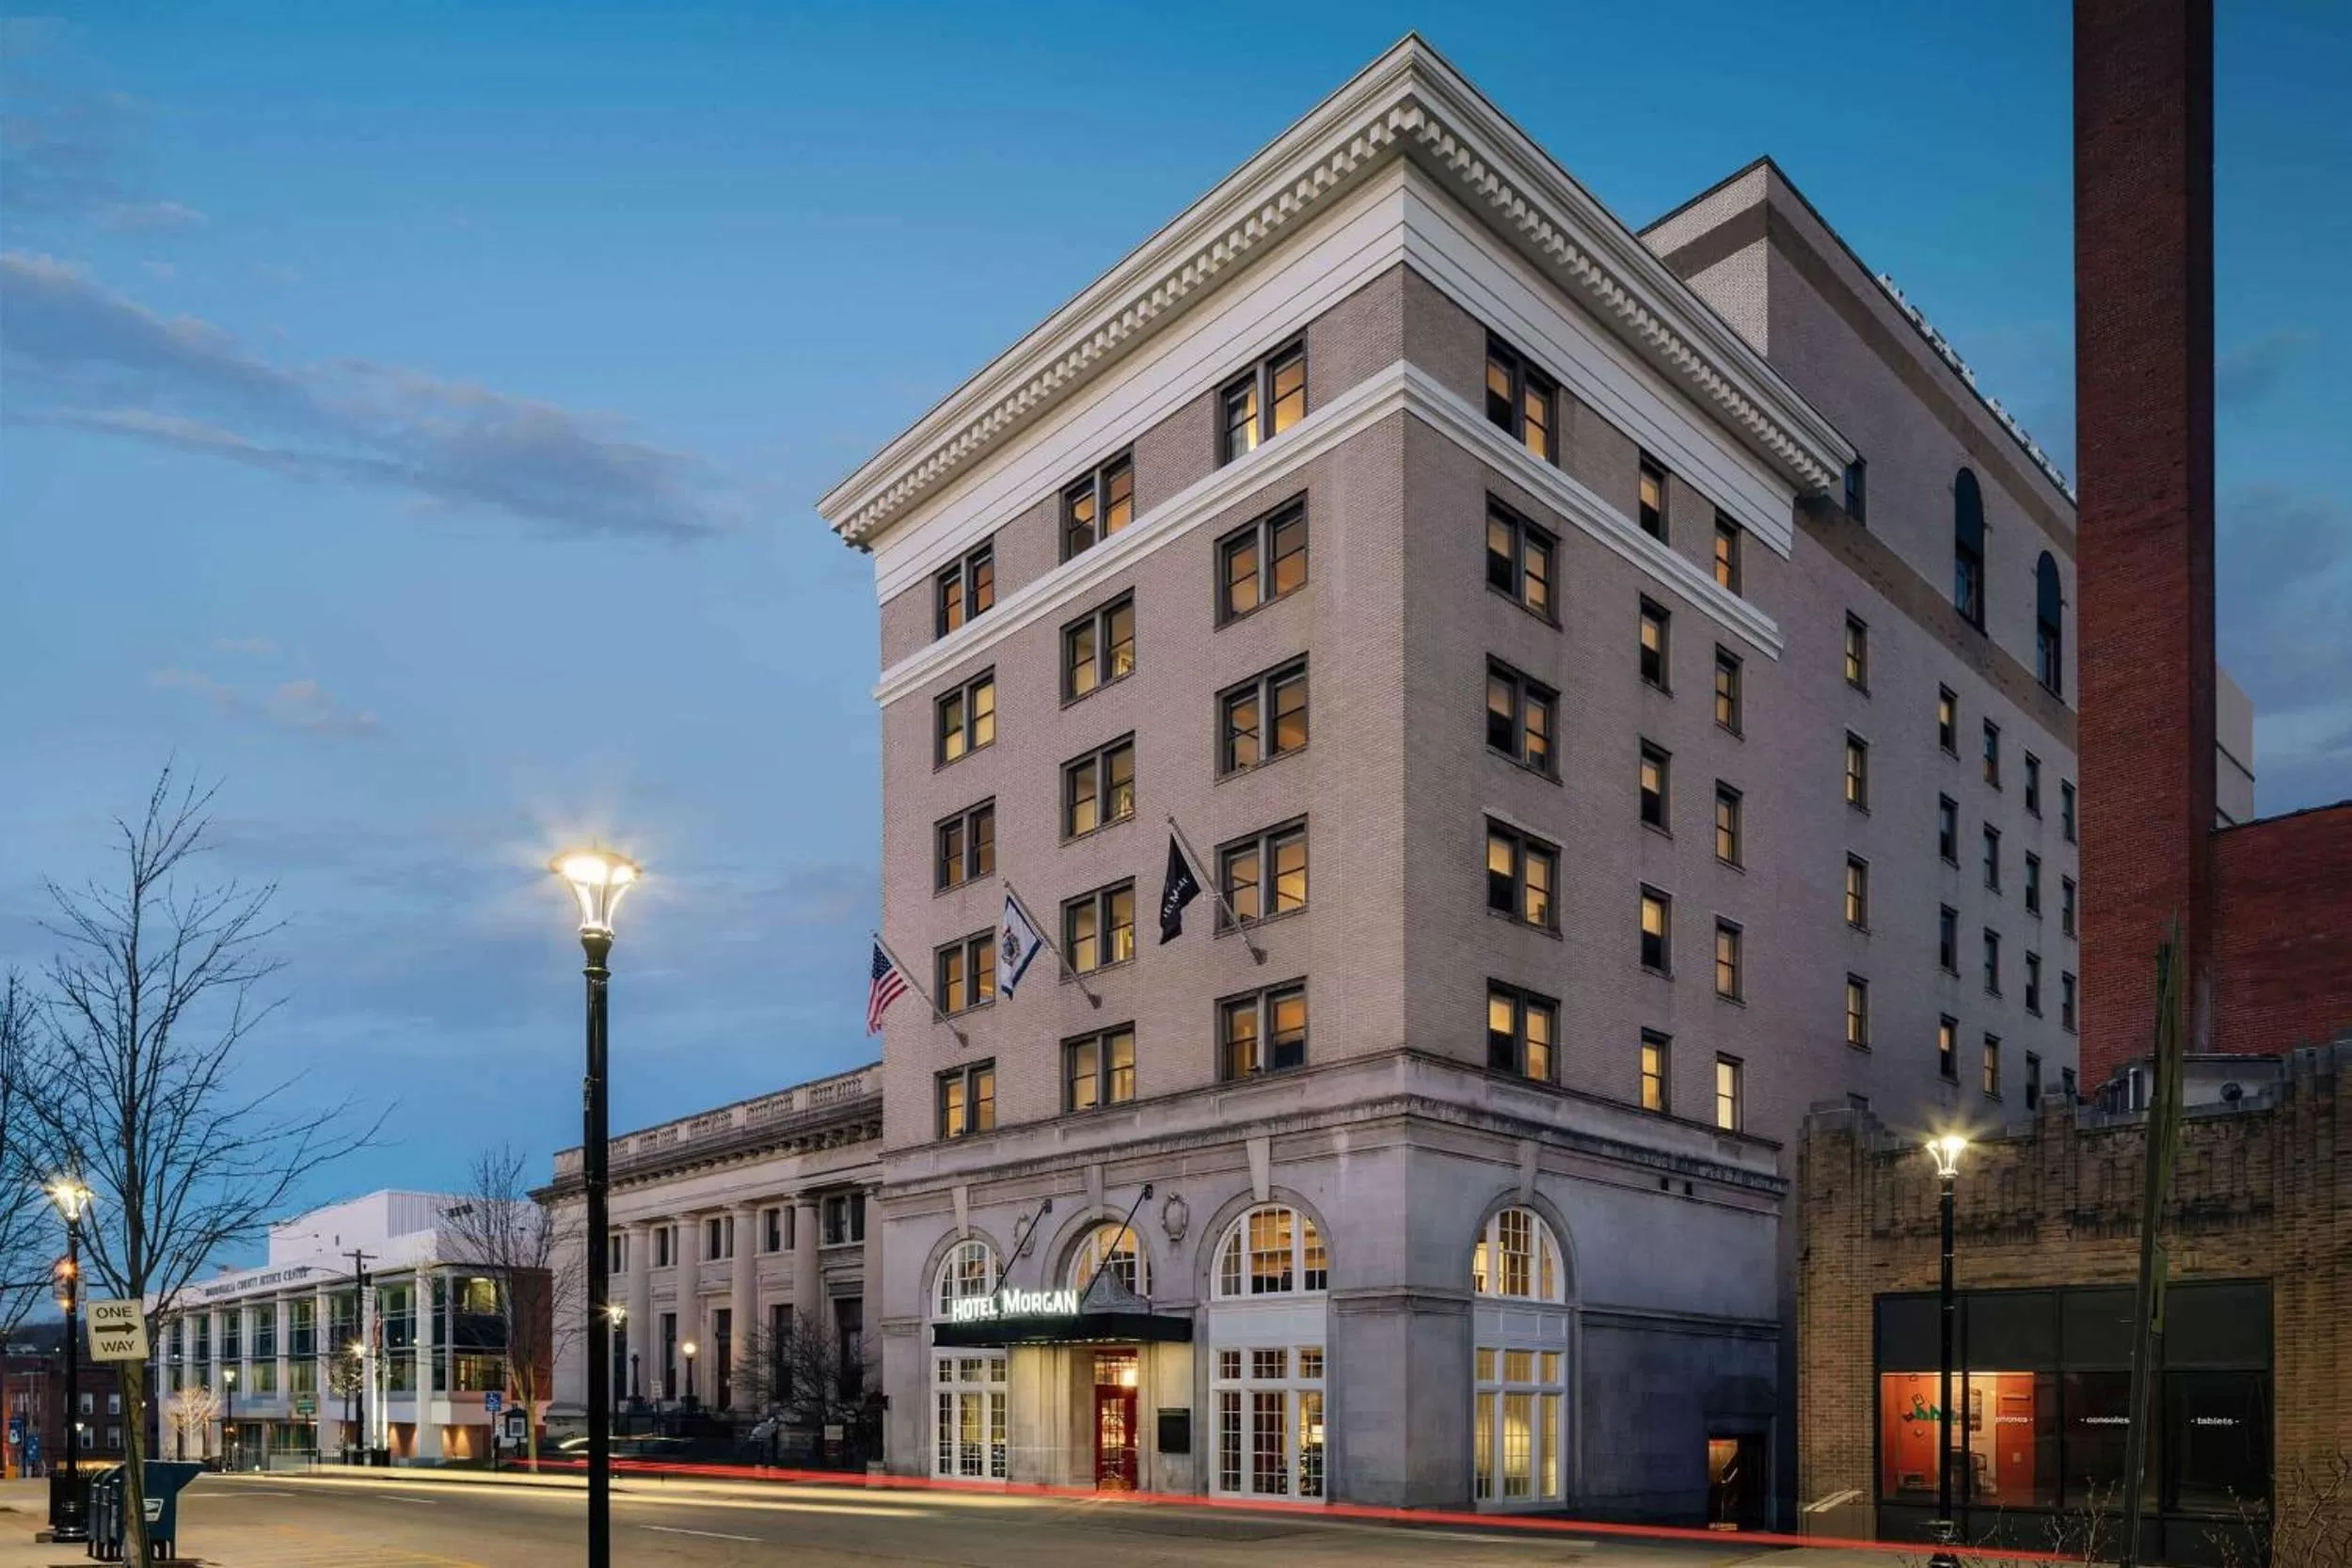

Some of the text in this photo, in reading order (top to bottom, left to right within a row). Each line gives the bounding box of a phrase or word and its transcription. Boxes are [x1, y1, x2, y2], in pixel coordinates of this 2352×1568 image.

[952, 1288, 1078, 1322] HOTEL MORGAN
[96, 1306, 134, 1319] ONE
[101, 1339, 135, 1354] WAY
[2197, 1417, 2234, 1425] tablets
